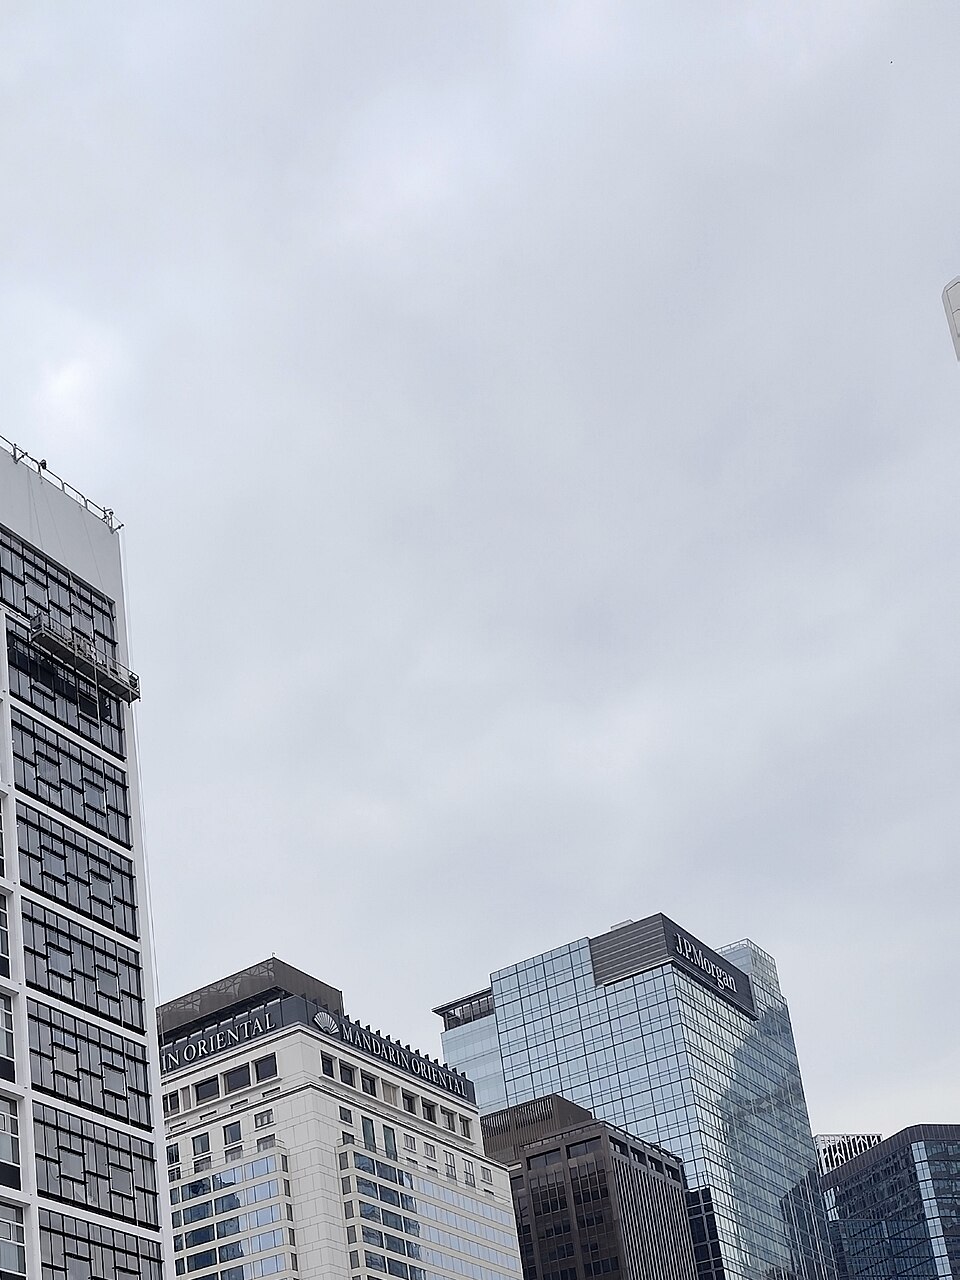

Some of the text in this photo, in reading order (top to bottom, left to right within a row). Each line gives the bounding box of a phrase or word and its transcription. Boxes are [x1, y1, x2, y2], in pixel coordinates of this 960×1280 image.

[183, 1012, 276, 1061] ORIENTAL
[342, 1023, 468, 1098] MANDARIN ORIENTAL
